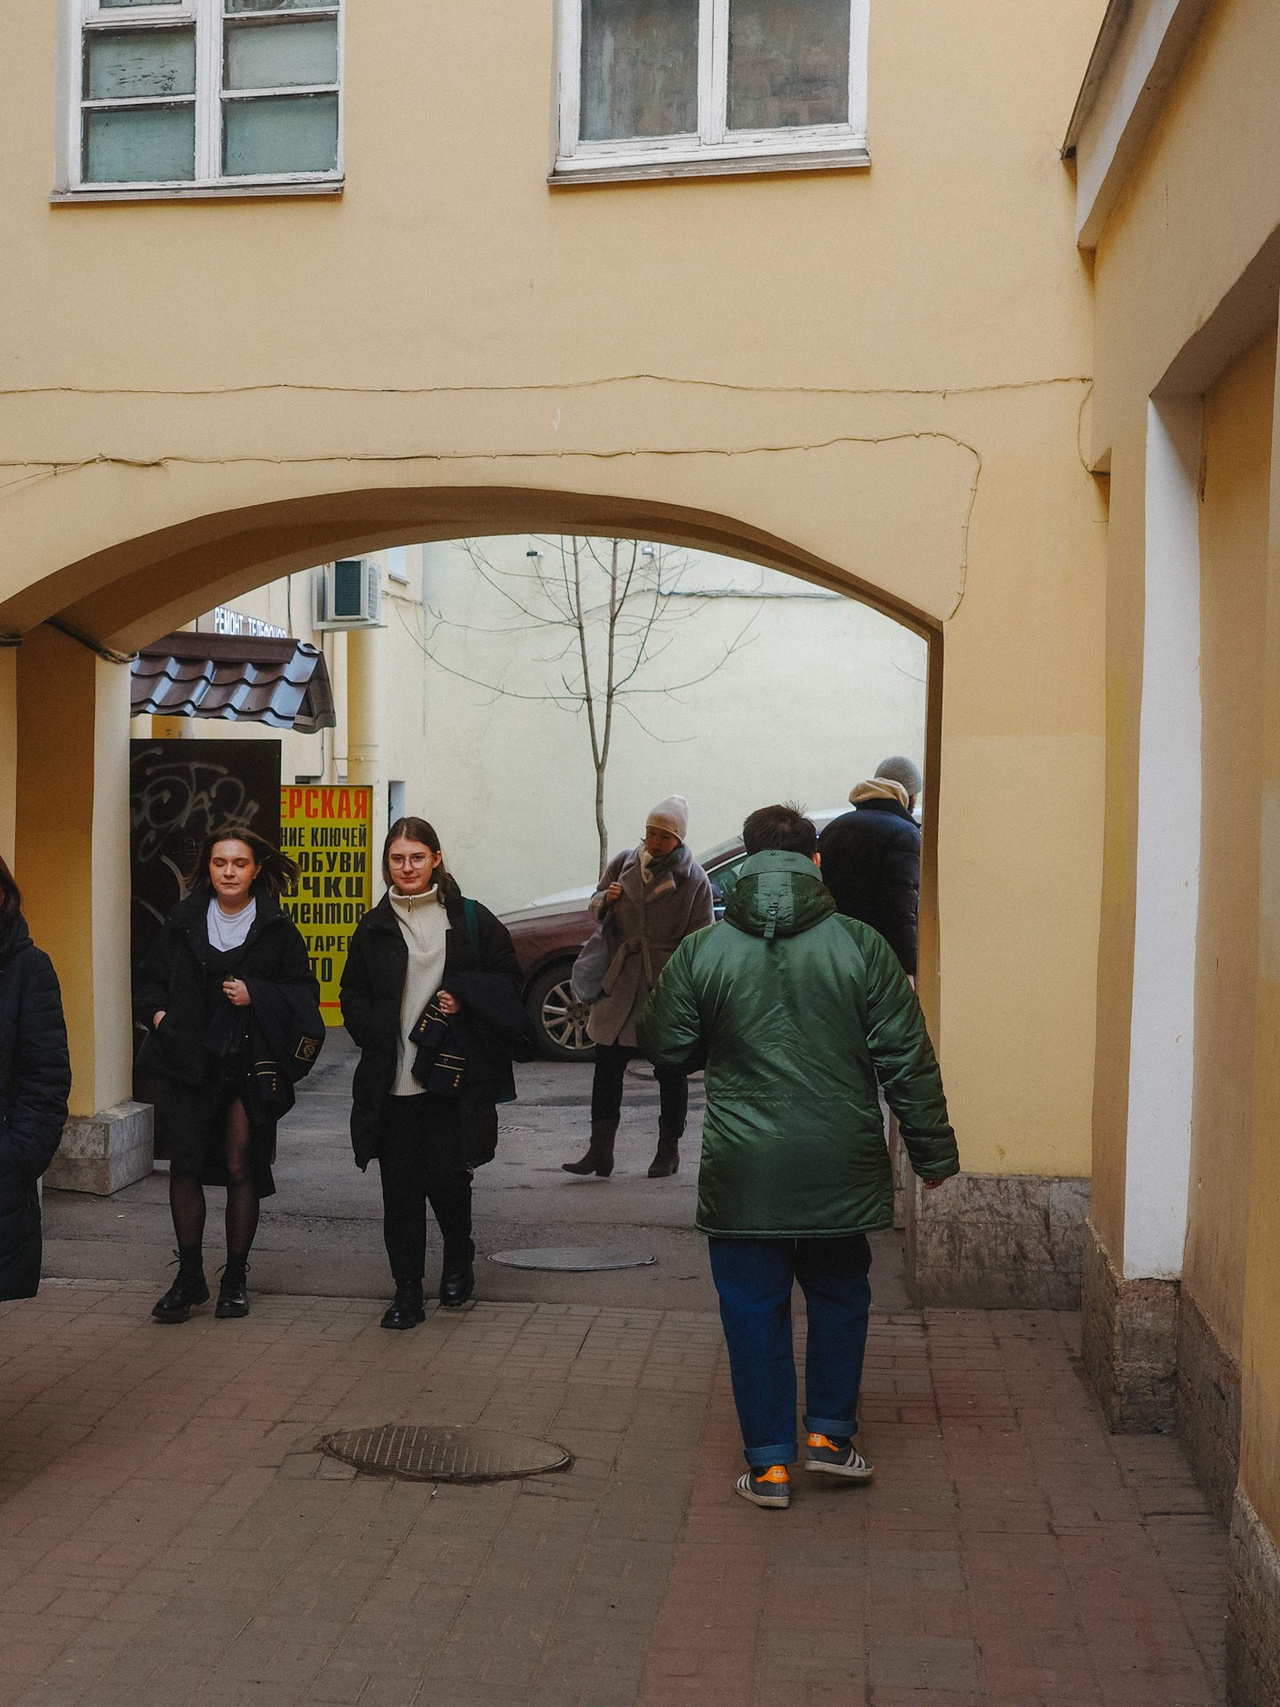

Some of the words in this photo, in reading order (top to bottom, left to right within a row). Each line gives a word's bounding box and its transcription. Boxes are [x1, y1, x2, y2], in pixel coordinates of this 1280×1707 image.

[214, 606, 243, 635] РЕМОНТ
[311, 823, 367, 847] КЛЮЧЕЙ
[298, 851, 366, 873] ОБУВИ
